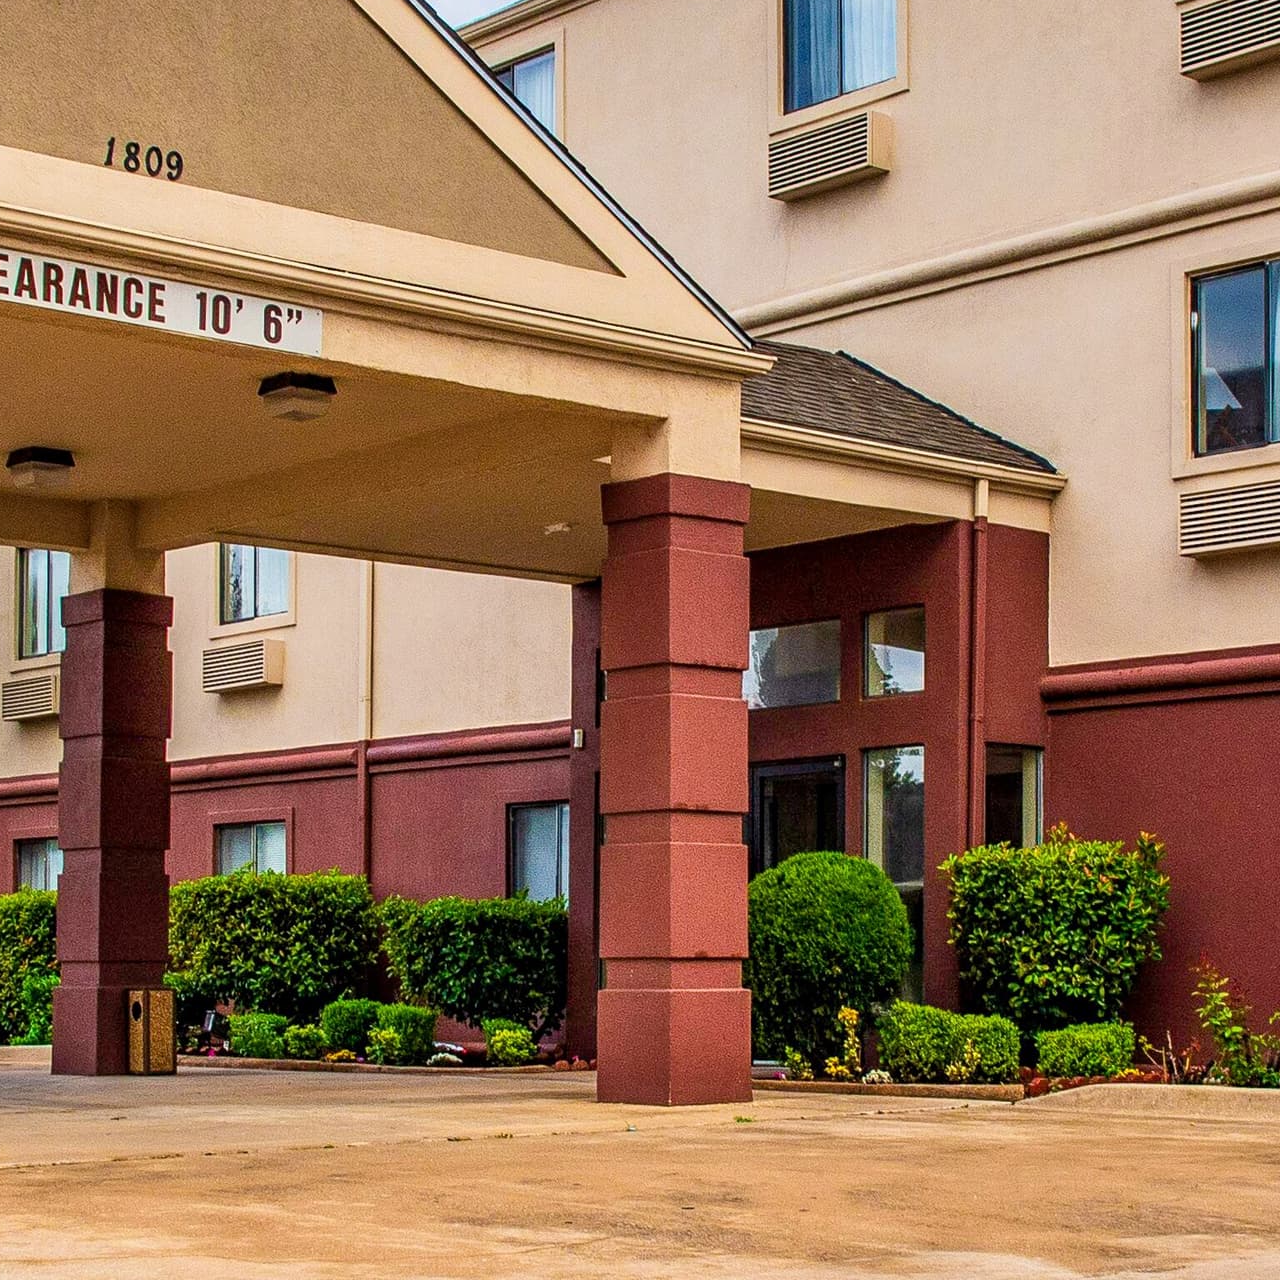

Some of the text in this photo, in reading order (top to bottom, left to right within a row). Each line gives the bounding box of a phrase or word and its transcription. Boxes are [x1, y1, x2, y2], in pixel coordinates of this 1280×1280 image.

[103, 136, 184, 181] 1809
[195, 290, 245, 336] 10'
[262, 303, 304, 345] 6"
